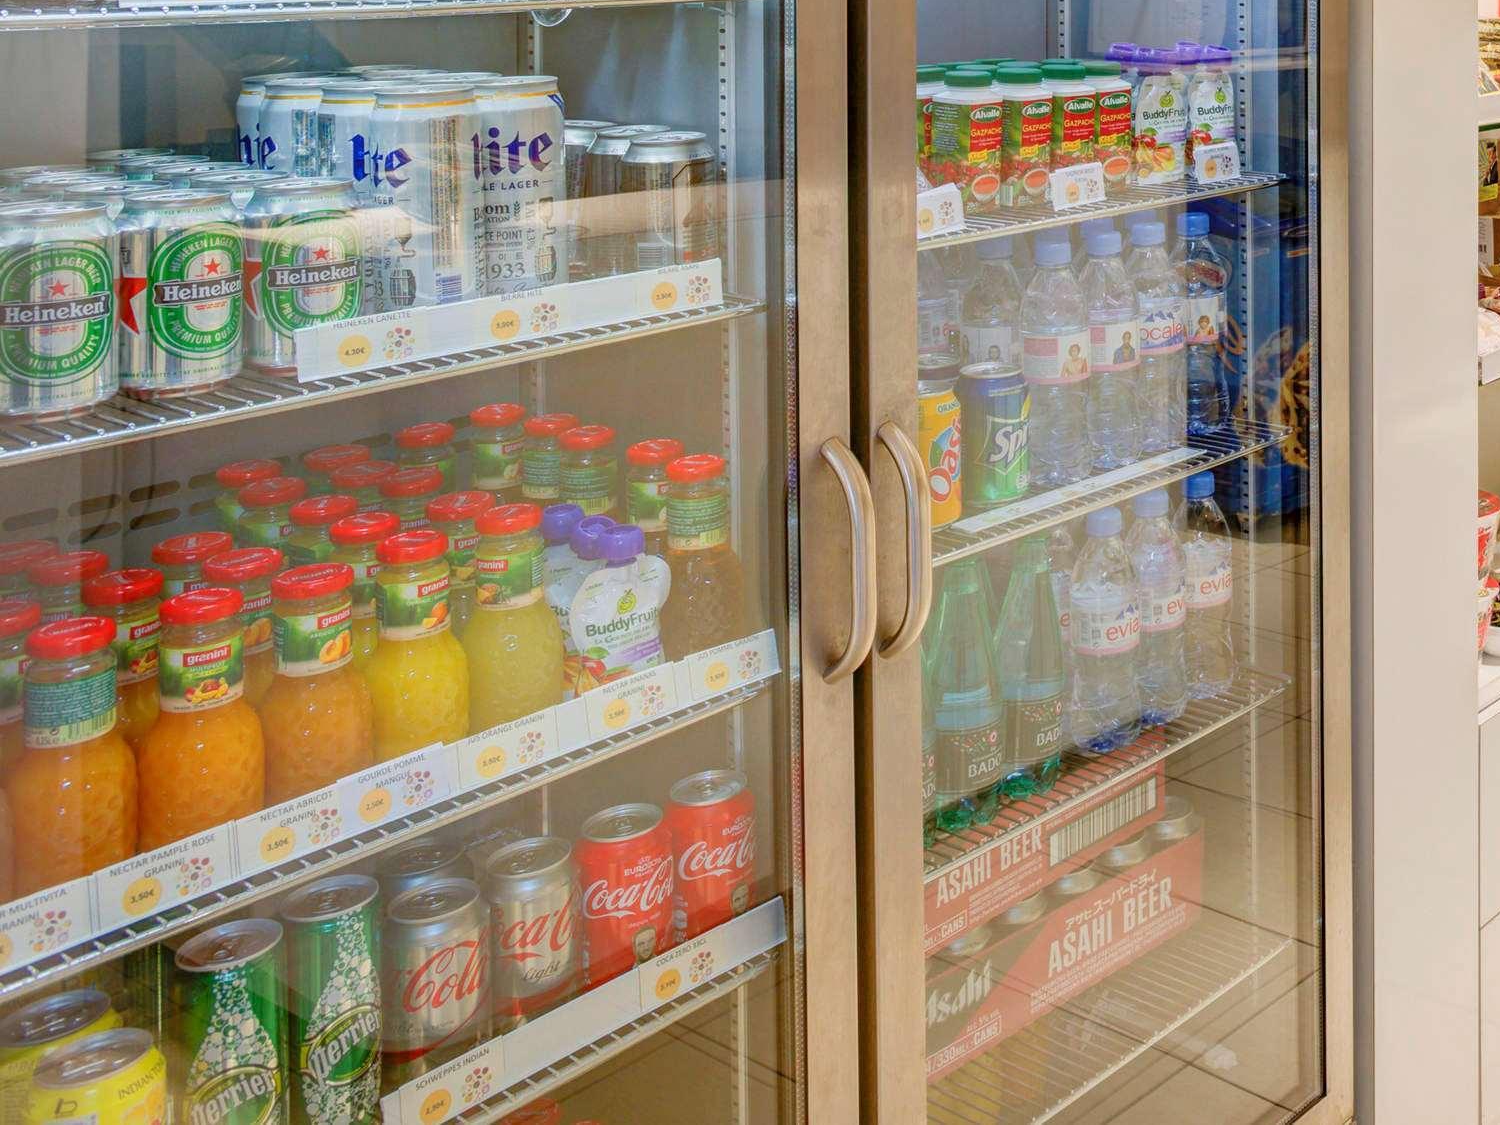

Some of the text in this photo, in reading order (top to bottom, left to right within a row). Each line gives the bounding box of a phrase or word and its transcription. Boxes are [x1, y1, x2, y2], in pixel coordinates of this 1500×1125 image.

[1025, 104, 1051, 116] Alvalle
[1068, 99, 1095, 111] Alvalle
[1103, 94, 1130, 107] Alvalle
[974, 108, 1001, 120] Alvalle
[501, 179, 541, 191] LAGER
[54, 257, 88, 269] LAGER
[275, 262, 359, 287] Heineken
[162, 277, 242, 303] Heineken
[3, 297, 106, 324] Heineken
[60, 333, 98, 370] QUALITY
[187, 647, 228, 665] granini
[481, 724, 514, 741] ORANGE
[357, 752, 427, 785] GOURDE POMME
[259, 789, 334, 824] NECTAR ABRICOT
[279, 808, 317, 829] GRANINI
[109, 831, 217, 879] NECTAR PAMPLE ROSE
[143, 856, 186, 879] GRANINI
[935, 851, 992, 909] ASAHI
[999, 827, 1043, 872] BEER
[8, 887, 68, 916] MULTIVITA
[1065, 870, 1157, 930] アサヒスーパードライ
[940, 913, 967, 936] CANS
[1048, 914, 1113, 978] ASAHI
[1122, 876, 1174, 934] BEER
[974, 1023, 1000, 1046] CANS
[415, 1047, 491, 1093] SCHWEPPES INDIAN
